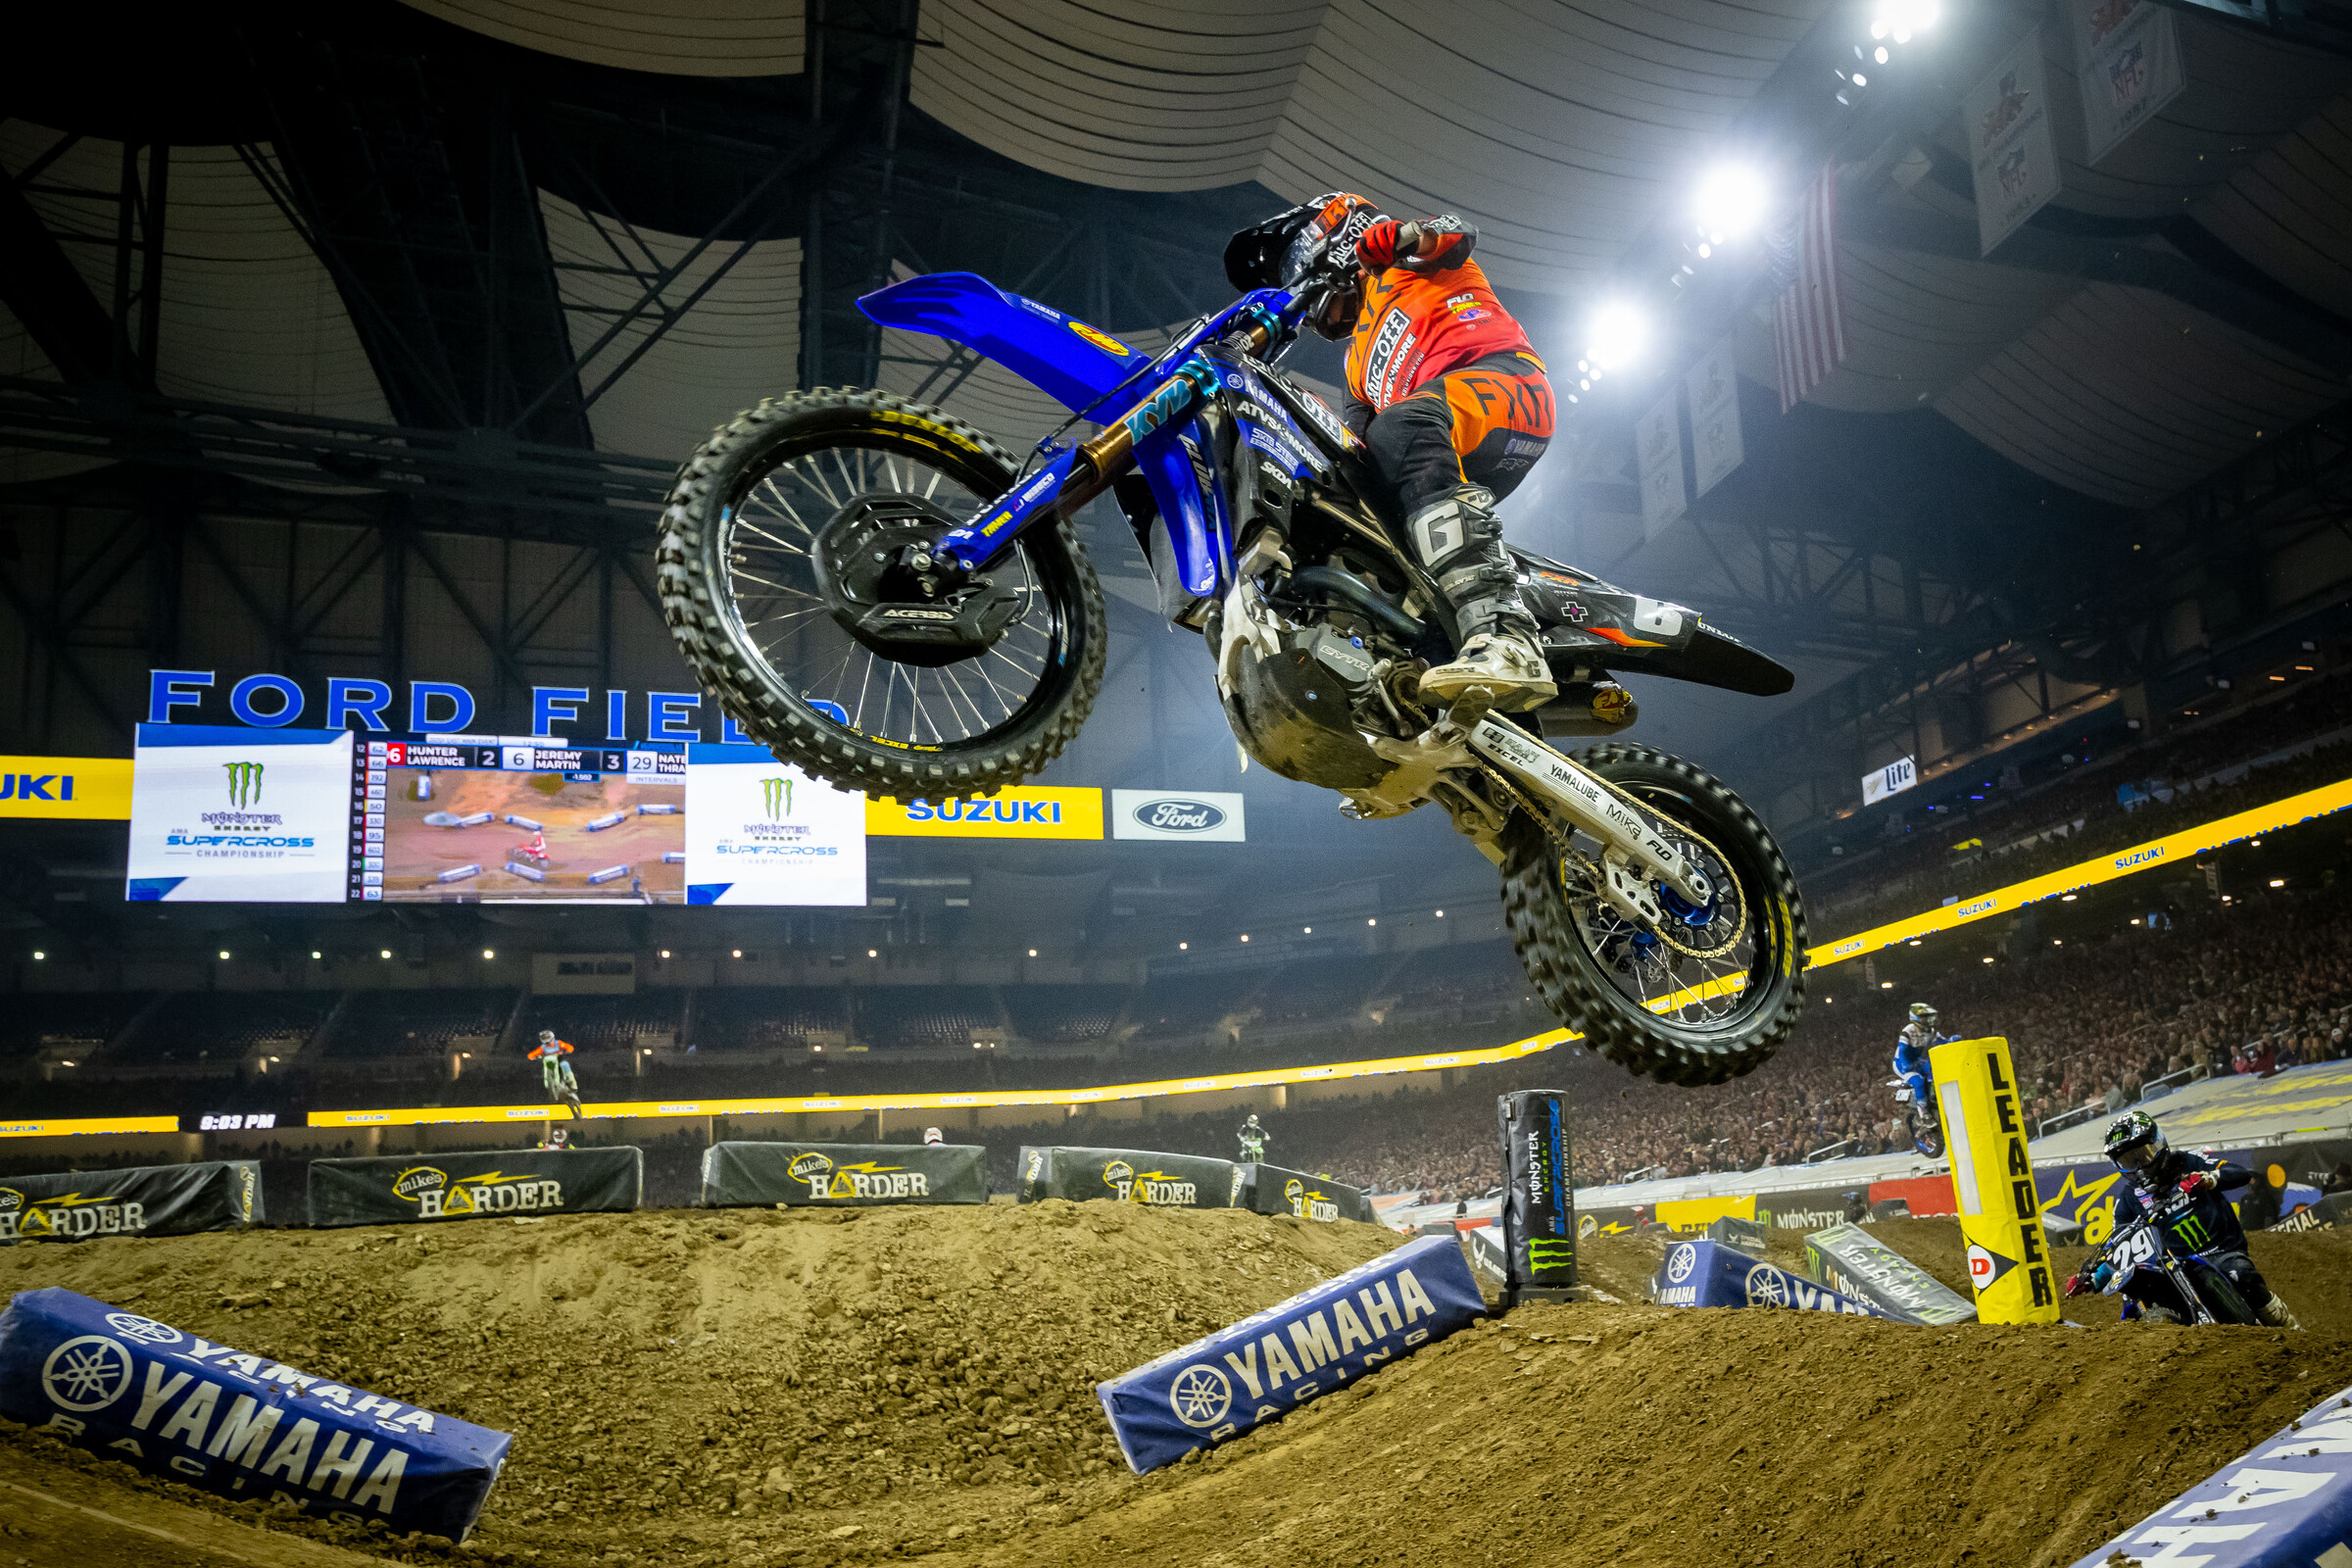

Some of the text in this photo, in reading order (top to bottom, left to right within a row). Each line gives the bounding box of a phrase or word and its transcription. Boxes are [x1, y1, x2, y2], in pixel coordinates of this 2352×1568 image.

[1030, 302, 1060, 320] YAMAHA
[1245, 380, 1288, 422] YAMAHA
[1414, 502, 1465, 567] G
[883, 607, 955, 620] ACERBIS
[147, 669, 851, 745] FORD FIEL
[387, 748, 401, 763] 6
[407, 746, 459, 757] HUNTER
[407, 756, 466, 767] LAWRENCE
[482, 751, 496, 765] 2
[513, 753, 524, 765] 6
[535, 750, 582, 760] JEREMY
[607, 755, 620, 769] 3
[659, 754, 686, 764] NATE
[1488, 744, 1524, 767] EXCEL
[535, 760, 581, 770] MARTIN
[632, 757, 652, 770] 29
[1550, 763, 1602, 804] YAMALUBE
[1885, 762, 1911, 792] Lite
[201, 811, 282, 825] MONSTER
[906, 798, 1061, 824] SUZUKI
[1152, 802, 1207, 829] Ford
[744, 823, 811, 835] MONSTER
[166, 835, 315, 848] SUPERCROSS
[716, 845, 838, 856] SUPERCROSS
[1645, 840, 1672, 861] FLO
[196, 850, 284, 858] CHAMPIONSHIP
[2114, 845, 2165, 870] SUZUKI
[1957, 898, 1997, 918] SUZUKI
[1834, 939, 1865, 956] SUZUKI
[200, 1113, 276, 1131] 9:03 PM
[793, 1157, 830, 1176] mike's
[1528, 1130, 1542, 1204] MONSTER
[1548, 1099, 1566, 1235] SUPERCROSS
[1561, 1128, 1571, 1207] CHAMPIONSHIP
[399, 1171, 444, 1195] mike's
[808, 1172, 930, 1200] HARDER
[1986, 1053, 2053, 1308] LEADER
[417, 1180, 564, 1219] HARDER
[1116, 1180, 1198, 1205] HARDER
[1293, 1197, 1340, 1223] HARDER
[1777, 1208, 1845, 1230] MONSTER
[2112, 1226, 2155, 1271] 29
[1838, 1244, 1927, 1309] MONSTER
[1971, 1258, 1991, 1276] D
[1224, 1268, 1436, 1399] YAMAHA
[189, 1338, 437, 1434] YAMAHA
[1210, 1328, 1430, 1443] RACING
[130, 1361, 411, 1515] YAMAHA
